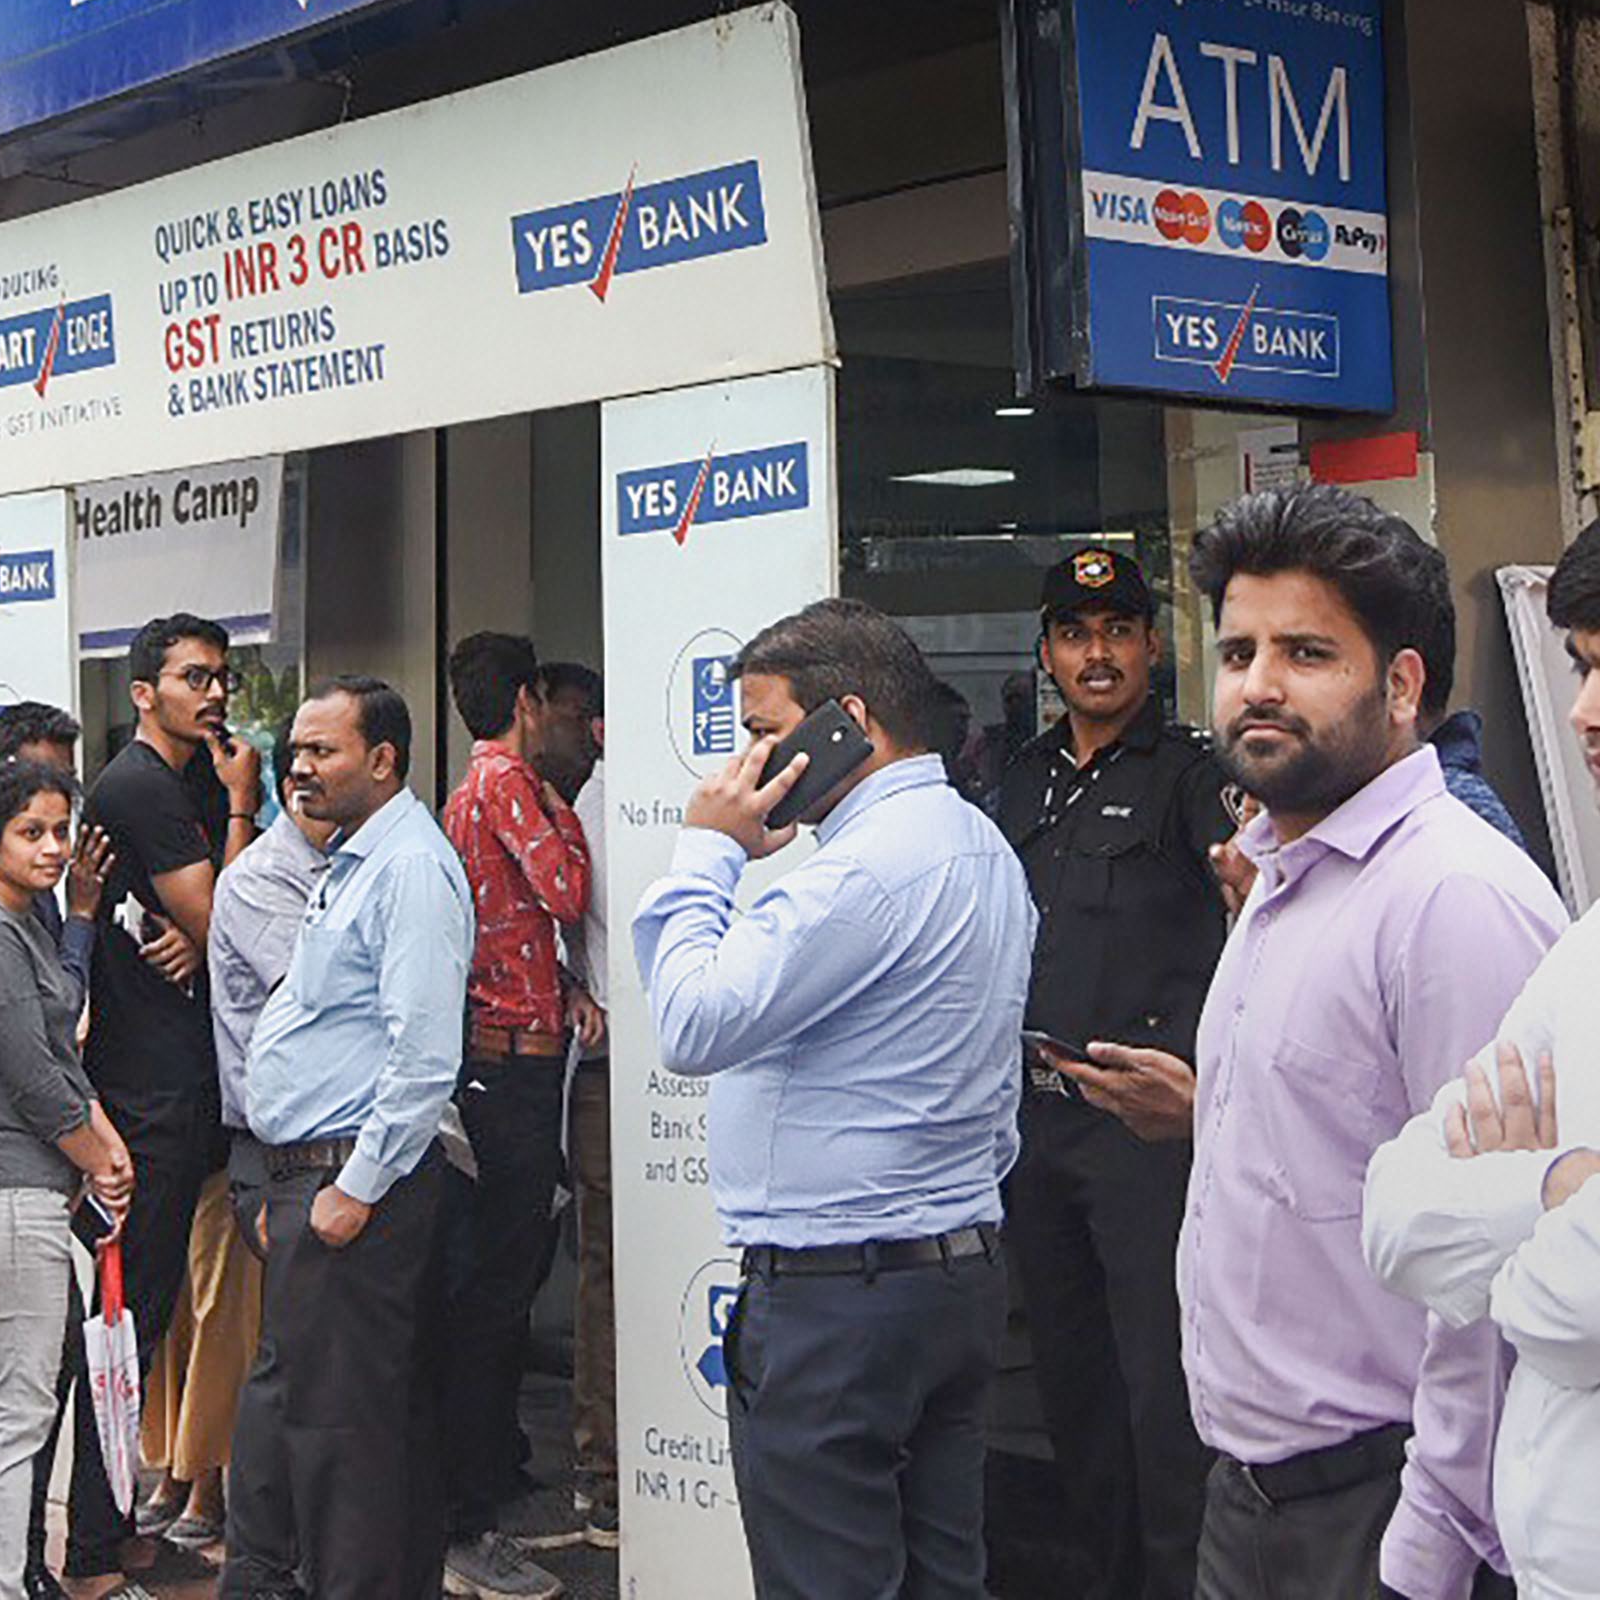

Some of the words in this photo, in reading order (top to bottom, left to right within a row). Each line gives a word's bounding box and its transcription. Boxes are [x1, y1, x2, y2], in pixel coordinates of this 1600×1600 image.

[1129, 32, 1351, 183] ATM
[155, 211, 221, 264] QUICK
[227, 207, 243, 241] &
[249, 189, 303, 235] EASY
[310, 169, 387, 220] LOANS
[524, 218, 594, 272] YES
[638, 182, 749, 250] BANK
[1089, 189, 1149, 226] VISA
[159, 279, 187, 315] UP
[192, 272, 218, 308] TO
[223, 242, 280, 301] INR
[287, 234, 308, 285] 3
[318, 221, 366, 279] CR
[373, 219, 450, 268] BASIS
[66, 311, 110, 356] EDGE
[165, 313, 221, 373] GST
[230, 305, 335, 359] RETURNS
[1166, 312, 1219, 350] YES
[1253, 323, 1328, 361] BANK
[168, 384, 185, 417] &
[190, 369, 250, 413] BANK
[253, 343, 385, 401] STATEMENT
[40, 396, 122, 431] INITIATIVE
[74, 486, 162, 540] Health
[172, 476, 260, 528] Camp
[626, 478, 677, 519] YES
[713, 458, 797, 507] BANK
[619, 801, 647, 827] No
[650, 1112, 693, 1141] Bank
[697, 1113, 707, 1142] S
[645, 1159, 676, 1184] and
[683, 1157, 709, 1184] GS
[645, 1427, 703, 1463] Credit
[636, 1469, 671, 1501] INR
[678, 1478, 686, 1504] 1
[694, 1480, 719, 1509] Cr
